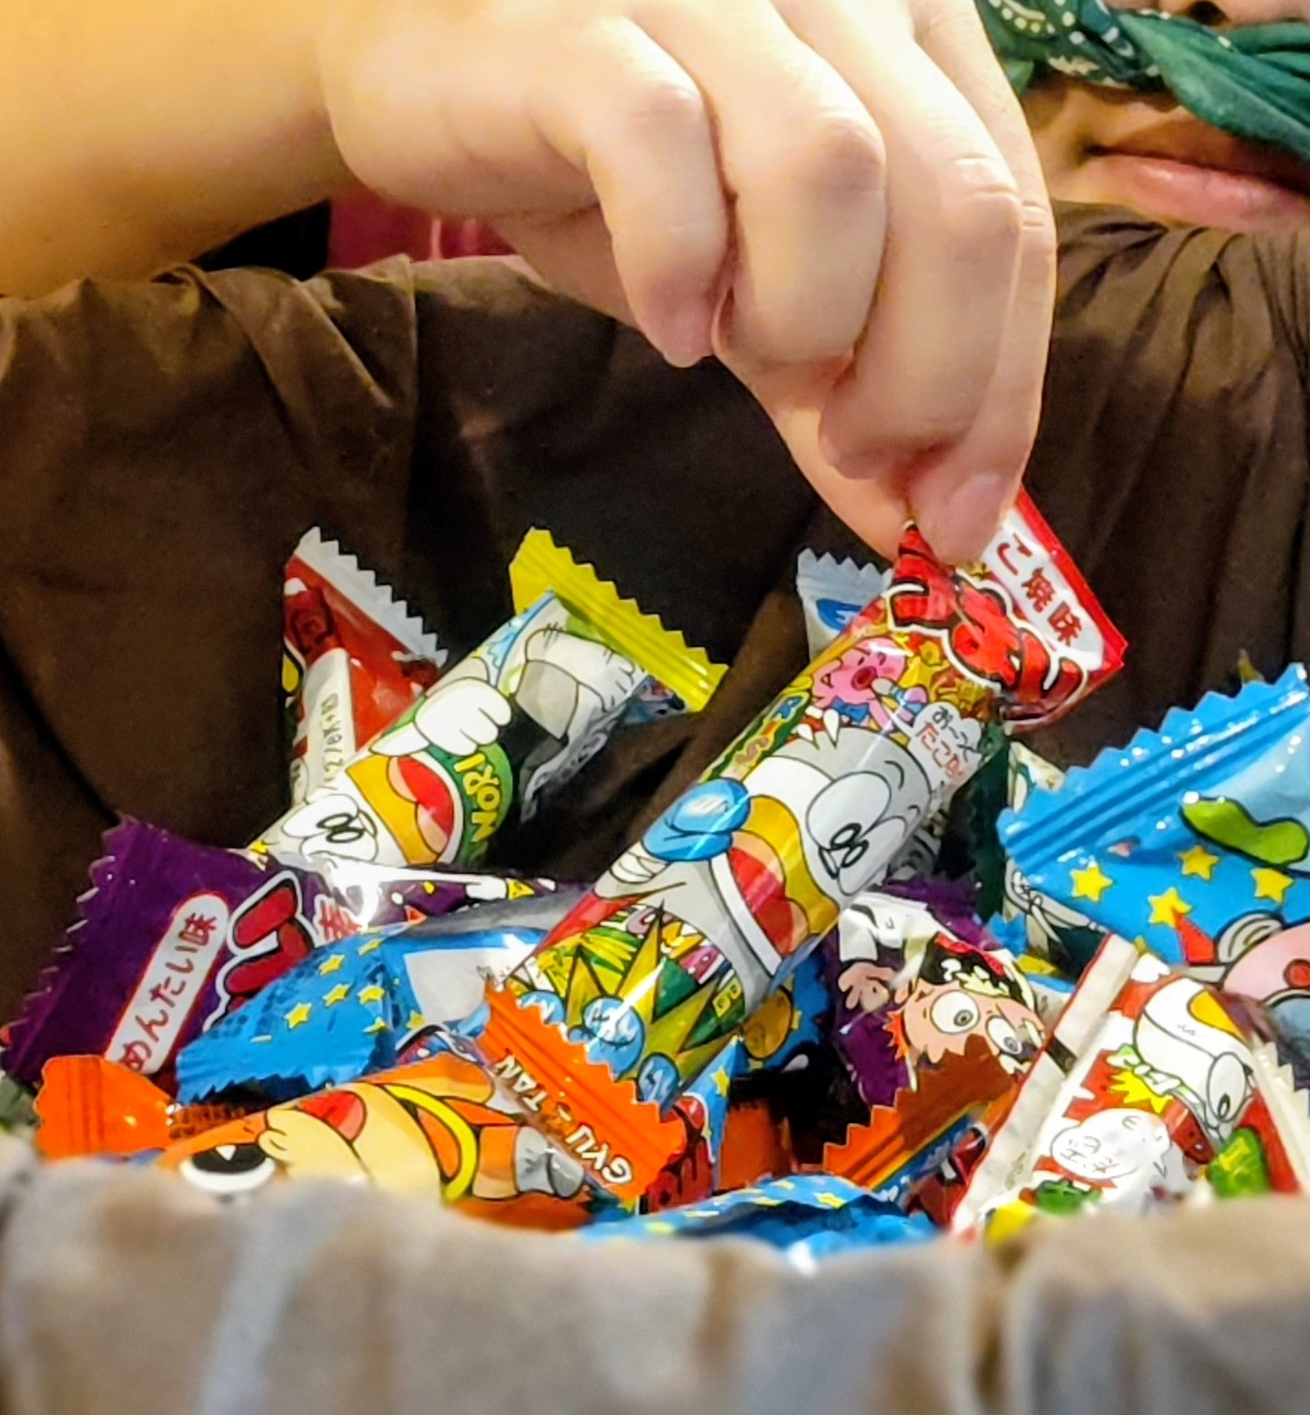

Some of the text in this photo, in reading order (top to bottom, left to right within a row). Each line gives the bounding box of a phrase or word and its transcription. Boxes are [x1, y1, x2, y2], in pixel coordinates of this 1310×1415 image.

[996, 532, 1083, 647] こ焼味
[454, 750, 501, 844] NORI
[121, 910, 220, 1071] めんたい味
